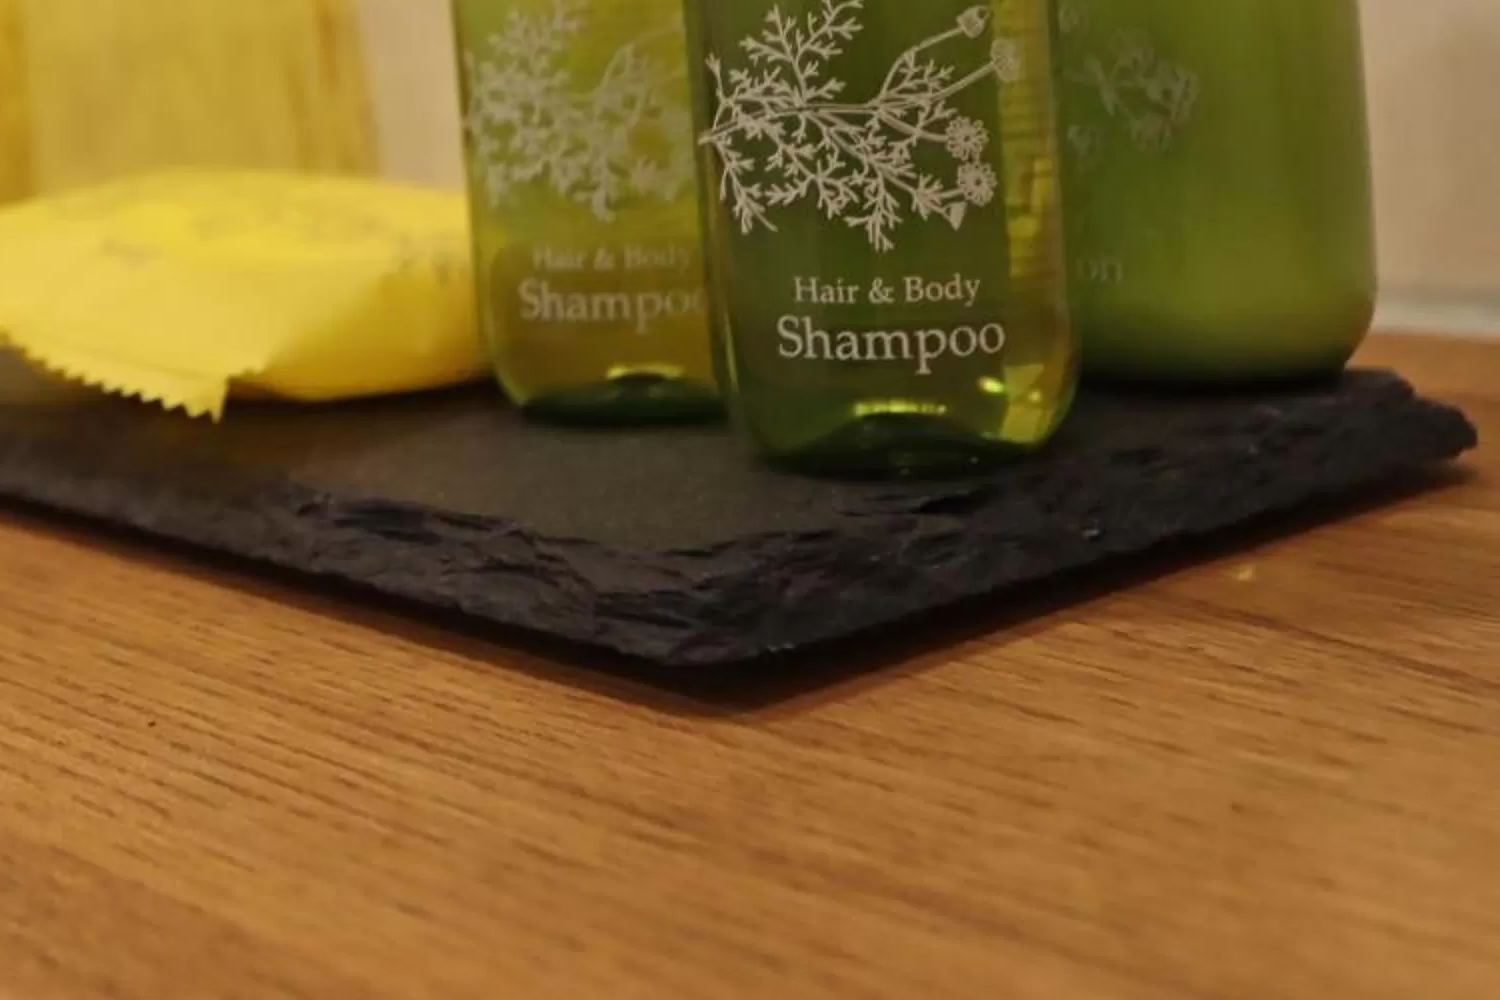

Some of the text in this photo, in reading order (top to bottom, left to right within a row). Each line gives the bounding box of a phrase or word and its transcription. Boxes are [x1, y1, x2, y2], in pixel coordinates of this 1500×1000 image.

[531, 243, 691, 274] Hair & Body
[793, 272, 981, 308] Hair & Body
[777, 314, 1006, 375] Shampoo
